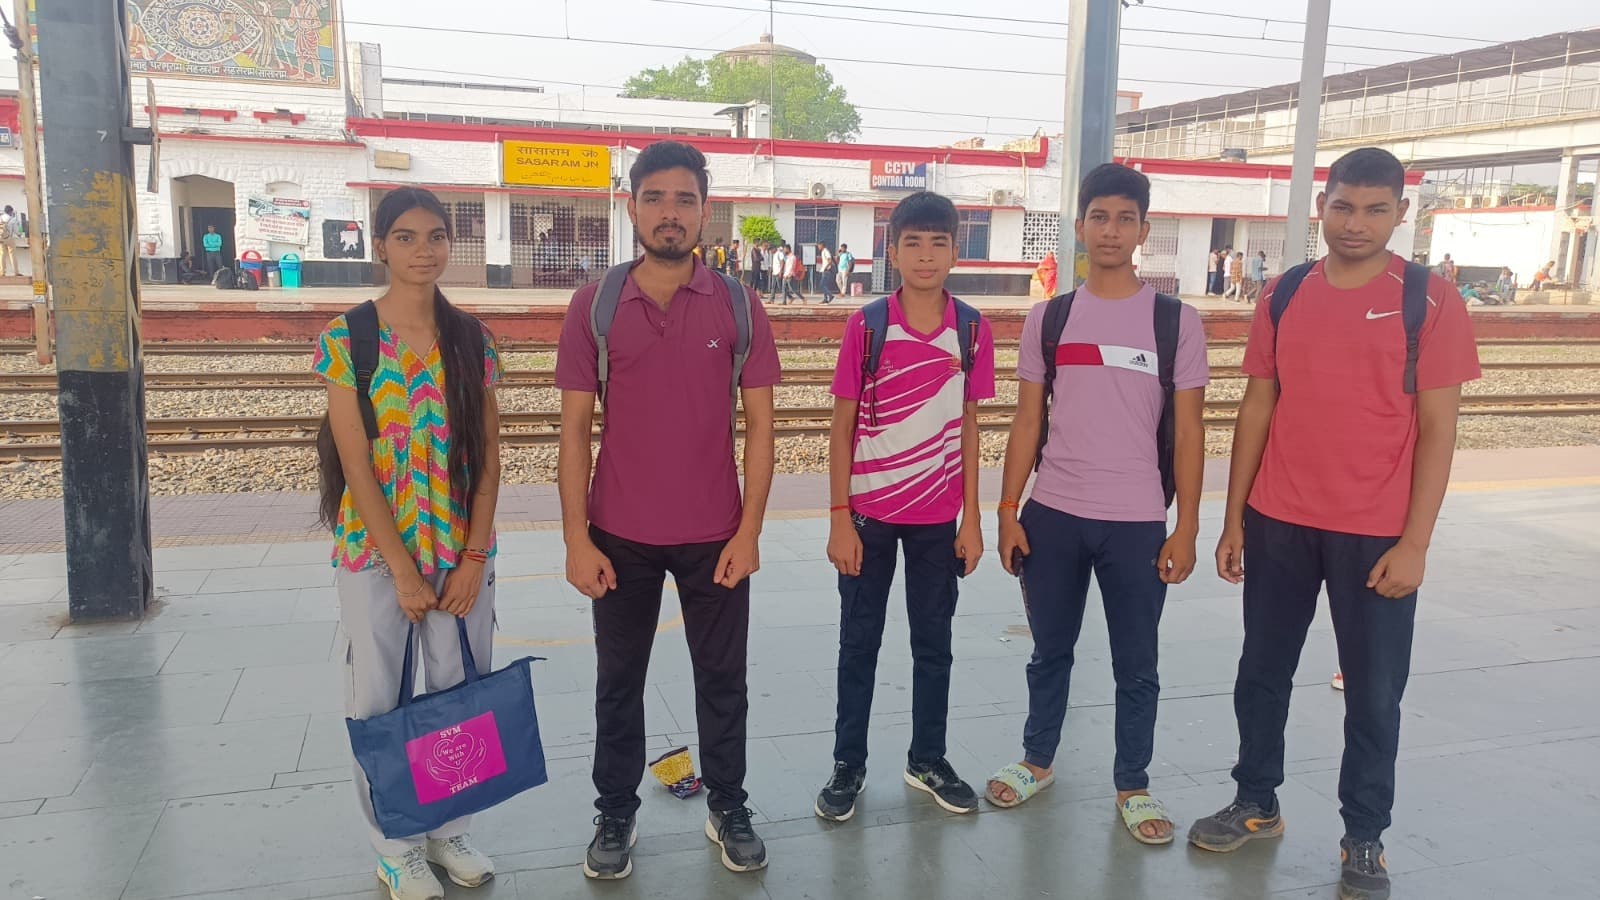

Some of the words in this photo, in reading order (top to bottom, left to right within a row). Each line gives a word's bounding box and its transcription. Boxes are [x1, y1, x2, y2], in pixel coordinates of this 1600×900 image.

[518, 146, 570, 157] सासाराम
[516, 158, 580, 168] SASARAM
[583, 161, 599, 169] JN
[885, 162, 915, 174] CCTV
[872, 175, 903, 187] CONTROL
[904, 176, 925, 187] ROOM
[440, 726, 461, 738] SVM
[442, 748, 454, 756] We
[456, 744, 466, 752] are
[450, 777, 478, 793] TEAM
